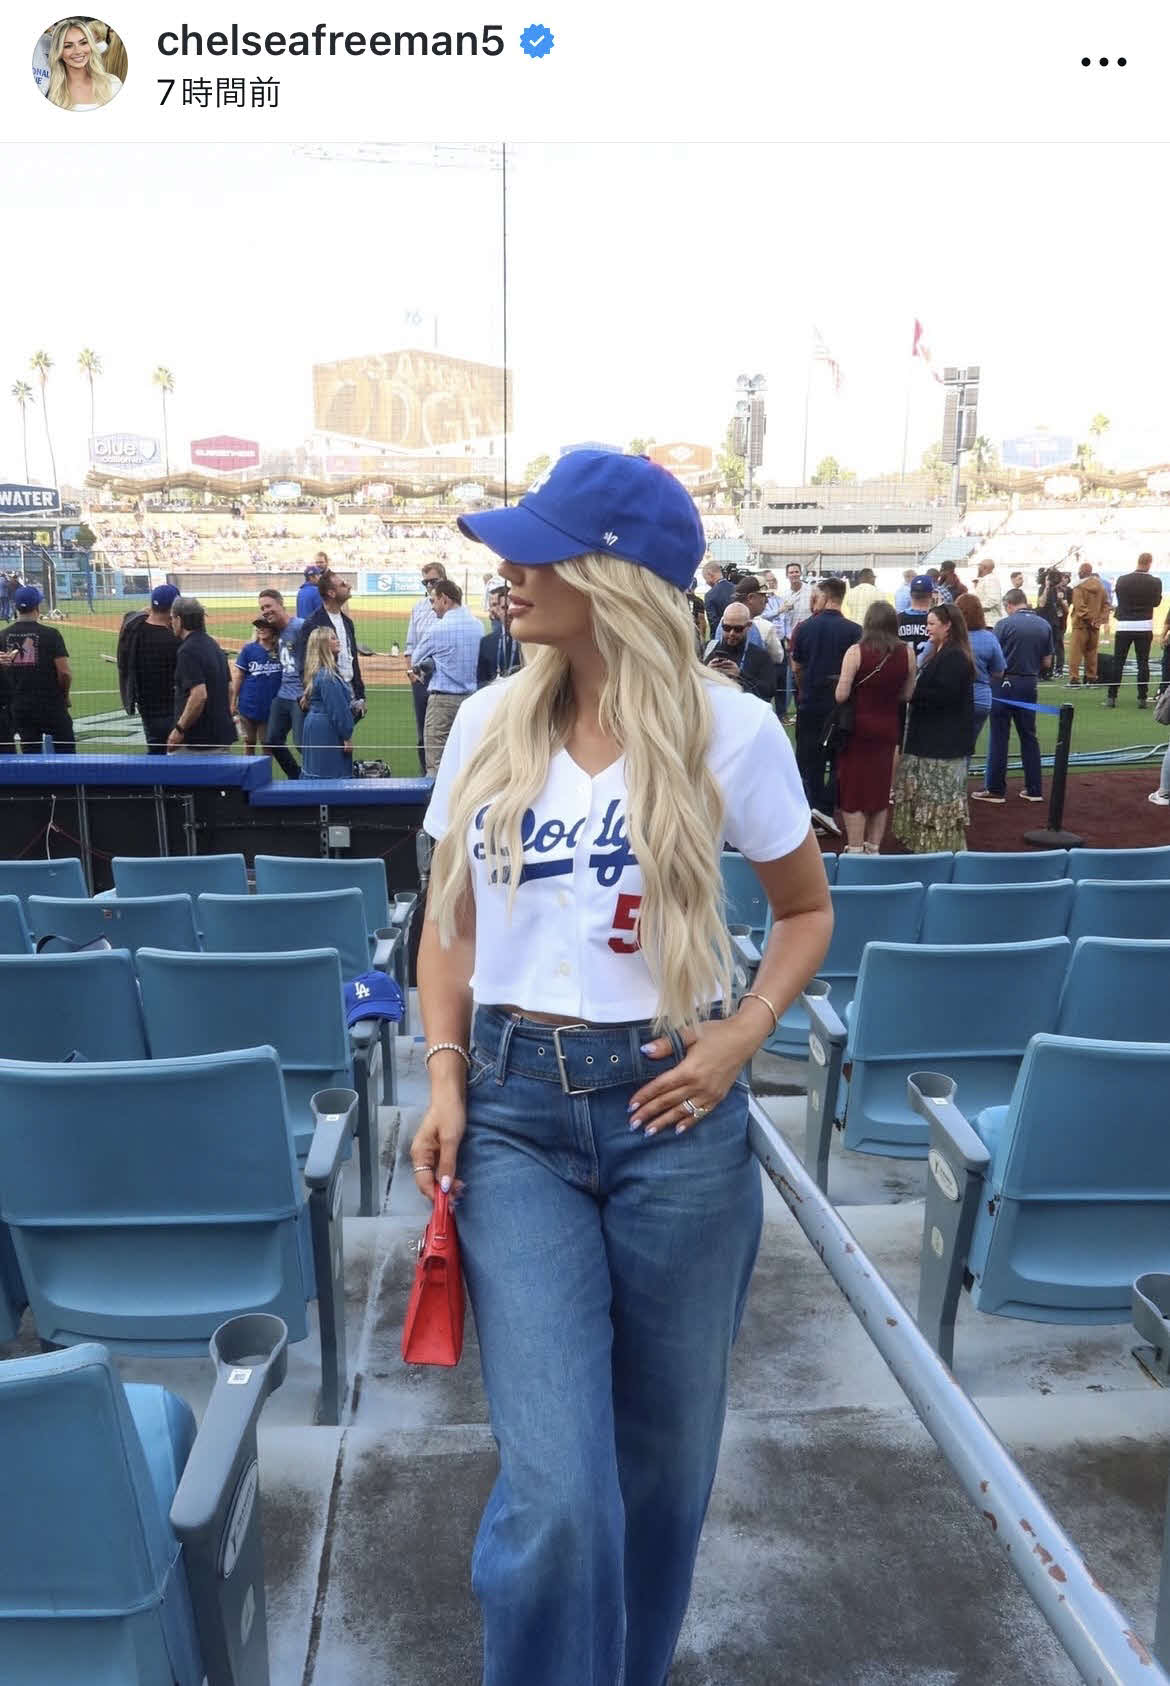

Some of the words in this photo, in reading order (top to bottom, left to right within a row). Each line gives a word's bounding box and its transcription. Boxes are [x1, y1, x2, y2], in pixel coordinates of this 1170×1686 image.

[95, 439, 137, 456] blue
[0, 491, 53, 506] WATER
[607, 892, 643, 954] 5
[354, 981, 371, 999] LA
